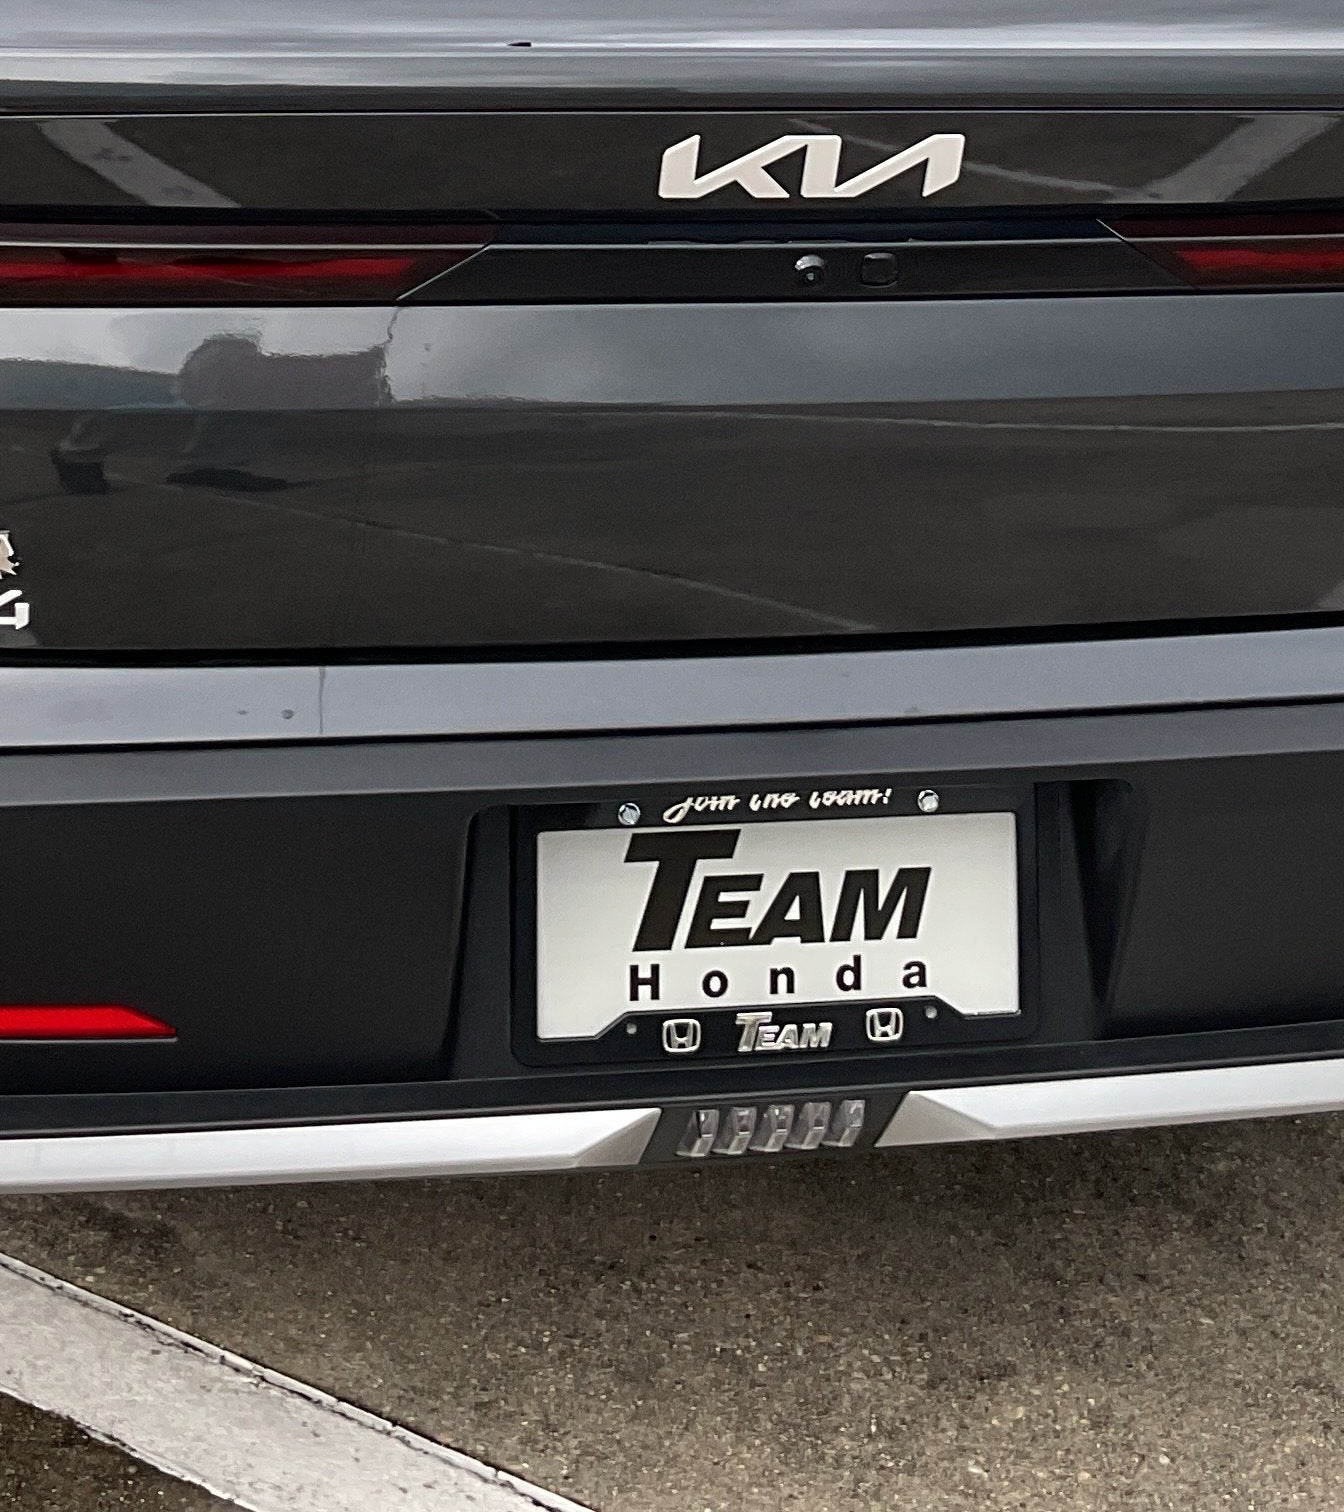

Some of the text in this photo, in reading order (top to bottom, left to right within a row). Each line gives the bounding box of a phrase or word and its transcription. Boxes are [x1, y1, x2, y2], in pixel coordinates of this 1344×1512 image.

[658, 134, 965, 198] KIA
[623, 828, 932, 953] TEAM
[628, 954, 928, 1002] Honda
[735, 1010, 834, 1053] TEAM
